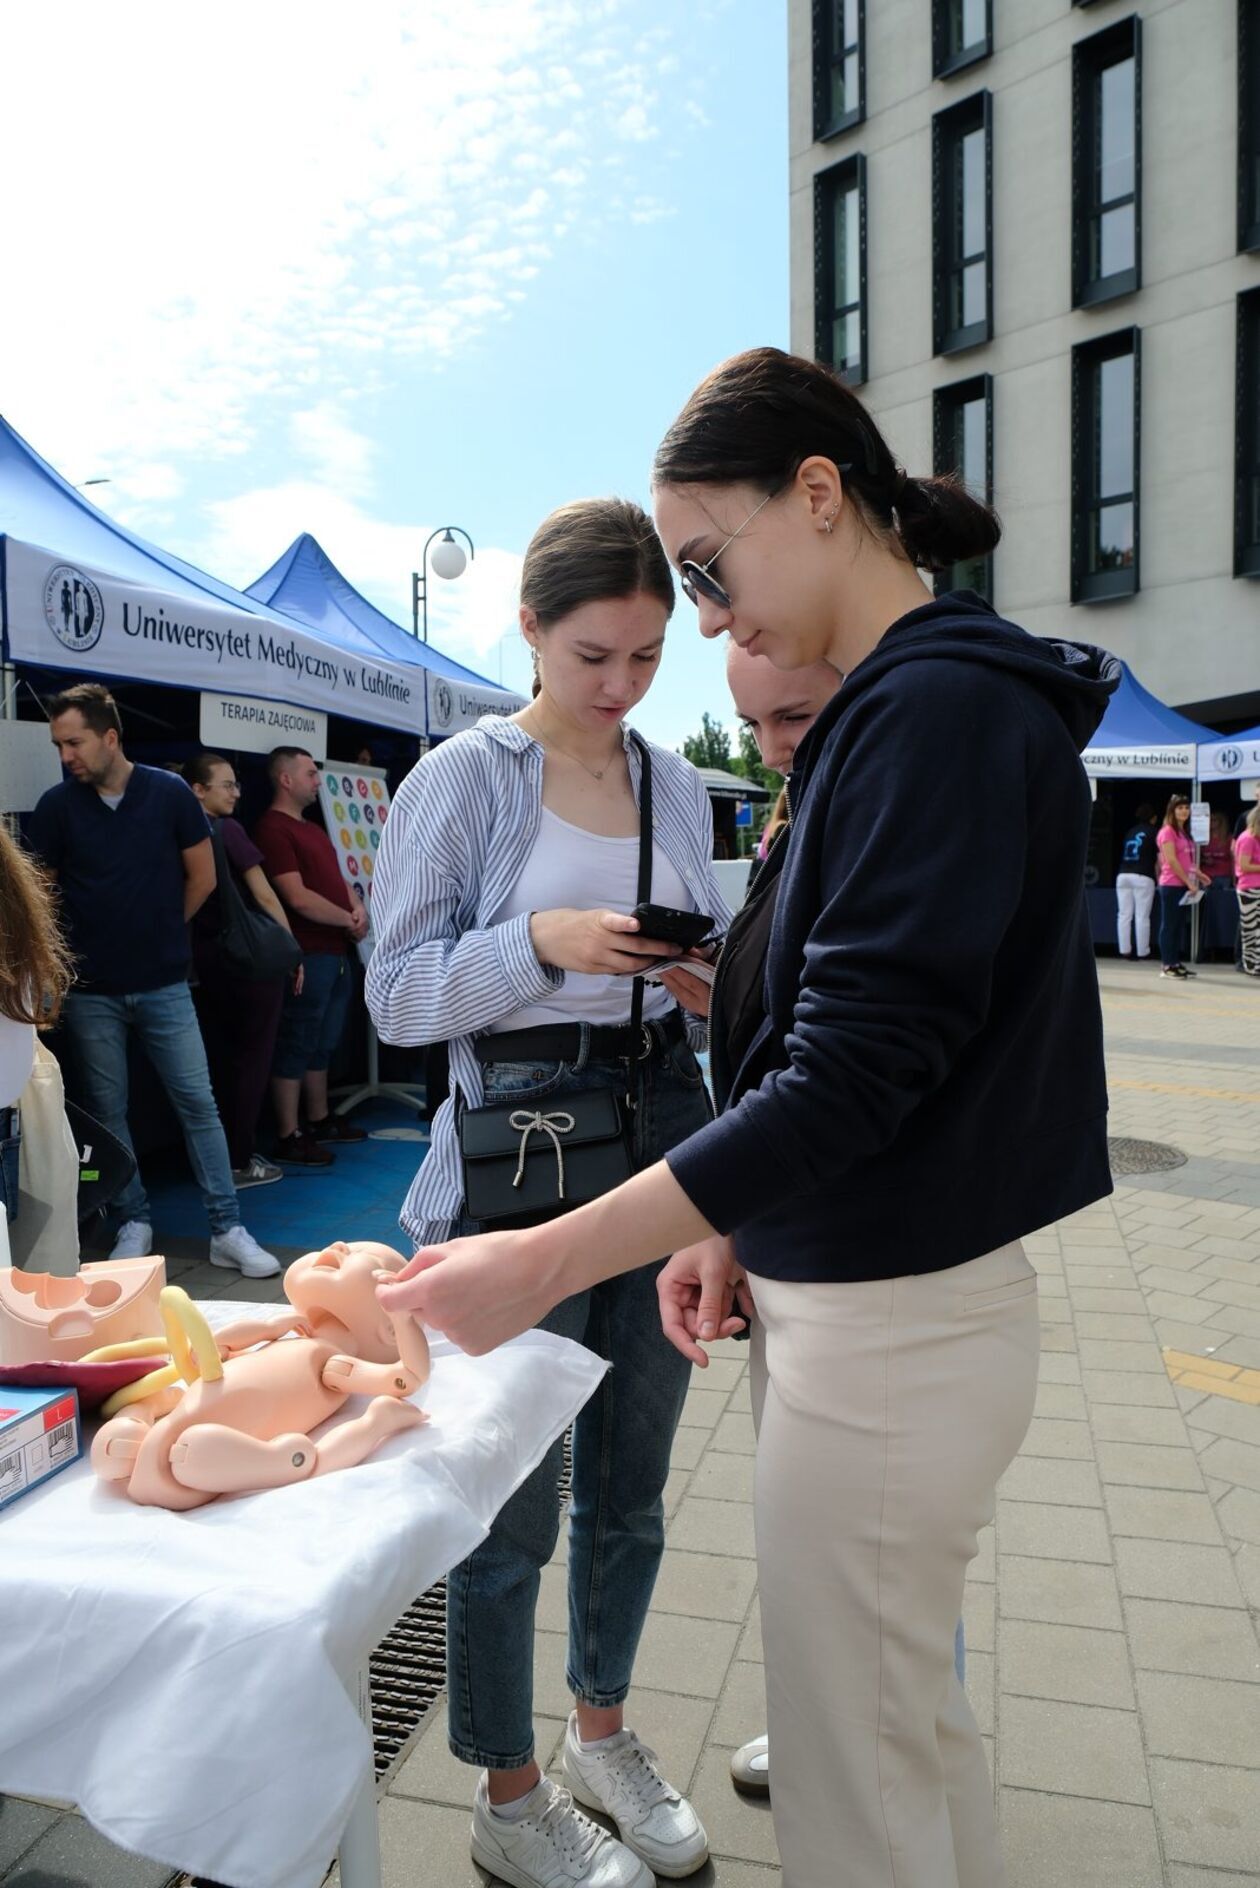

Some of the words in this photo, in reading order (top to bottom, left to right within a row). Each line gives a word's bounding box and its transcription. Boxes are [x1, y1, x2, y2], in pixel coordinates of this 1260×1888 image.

[123, 602, 251, 664] Uniwersytet
[258, 634, 339, 690] Medyczny
[343, 667, 357, 688] w
[361, 667, 411, 704] Lublinie
[221, 702, 266, 724] TERAPIA
[268, 711, 316, 733] ZAJĘCIOWA
[1117, 755, 1130, 765] w
[1133, 753, 1190, 766] Lublinie
[57, 1408, 63, 1421] L
